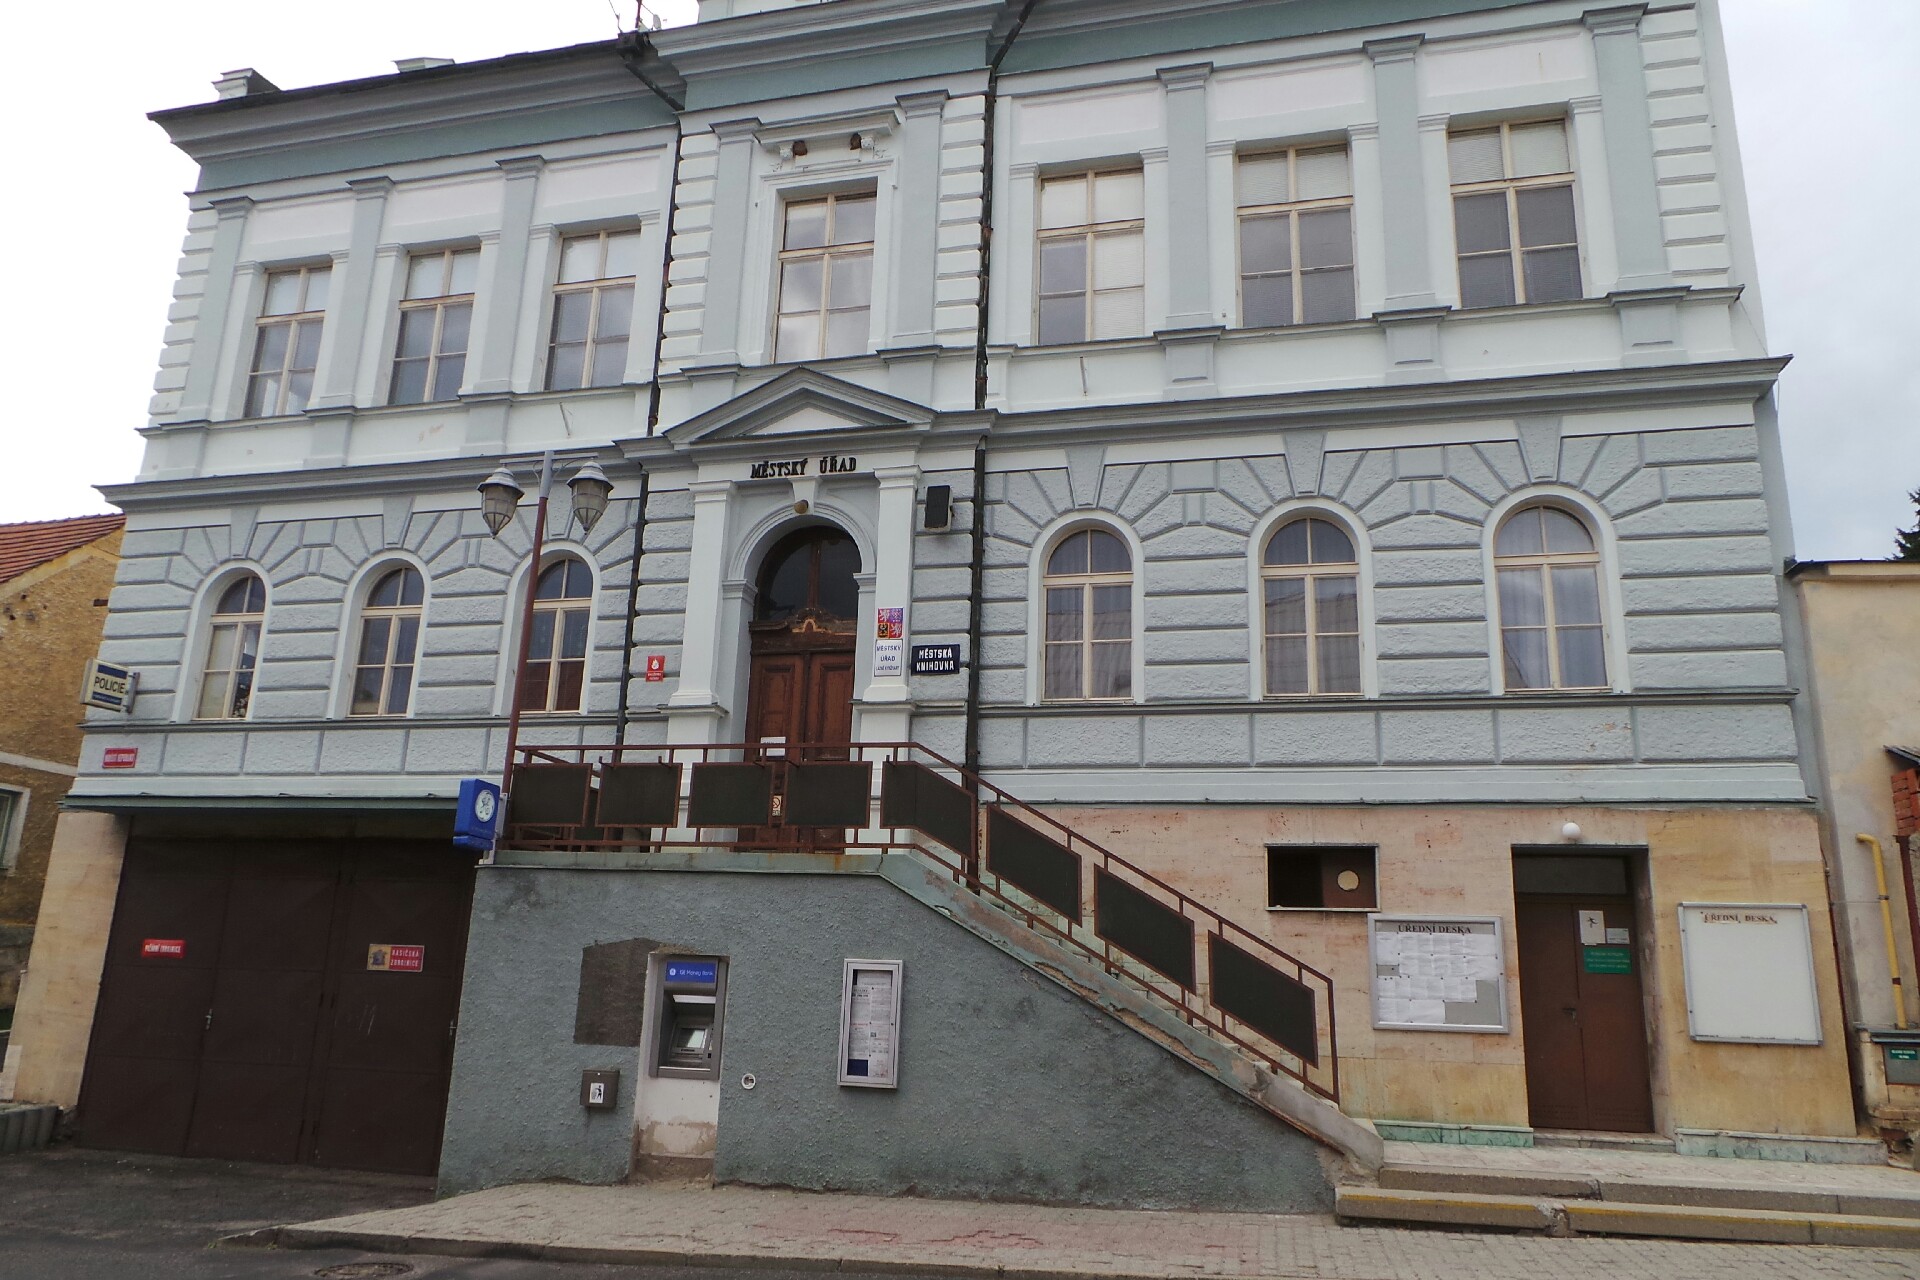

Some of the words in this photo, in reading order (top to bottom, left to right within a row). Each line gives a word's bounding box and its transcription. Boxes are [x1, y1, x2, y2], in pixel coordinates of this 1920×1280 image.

[750, 458, 808, 479] MĚSTSKÝ
[819, 456, 857, 474] ÚŘAD
[919, 647, 953, 659] MĚSTSKÁ
[916, 660, 955, 672] KNIHOVNA
[94, 676, 126, 694] POLICIE
[1745, 915, 1776, 923] DESKA
[1439, 925, 1472, 934] DESKA
